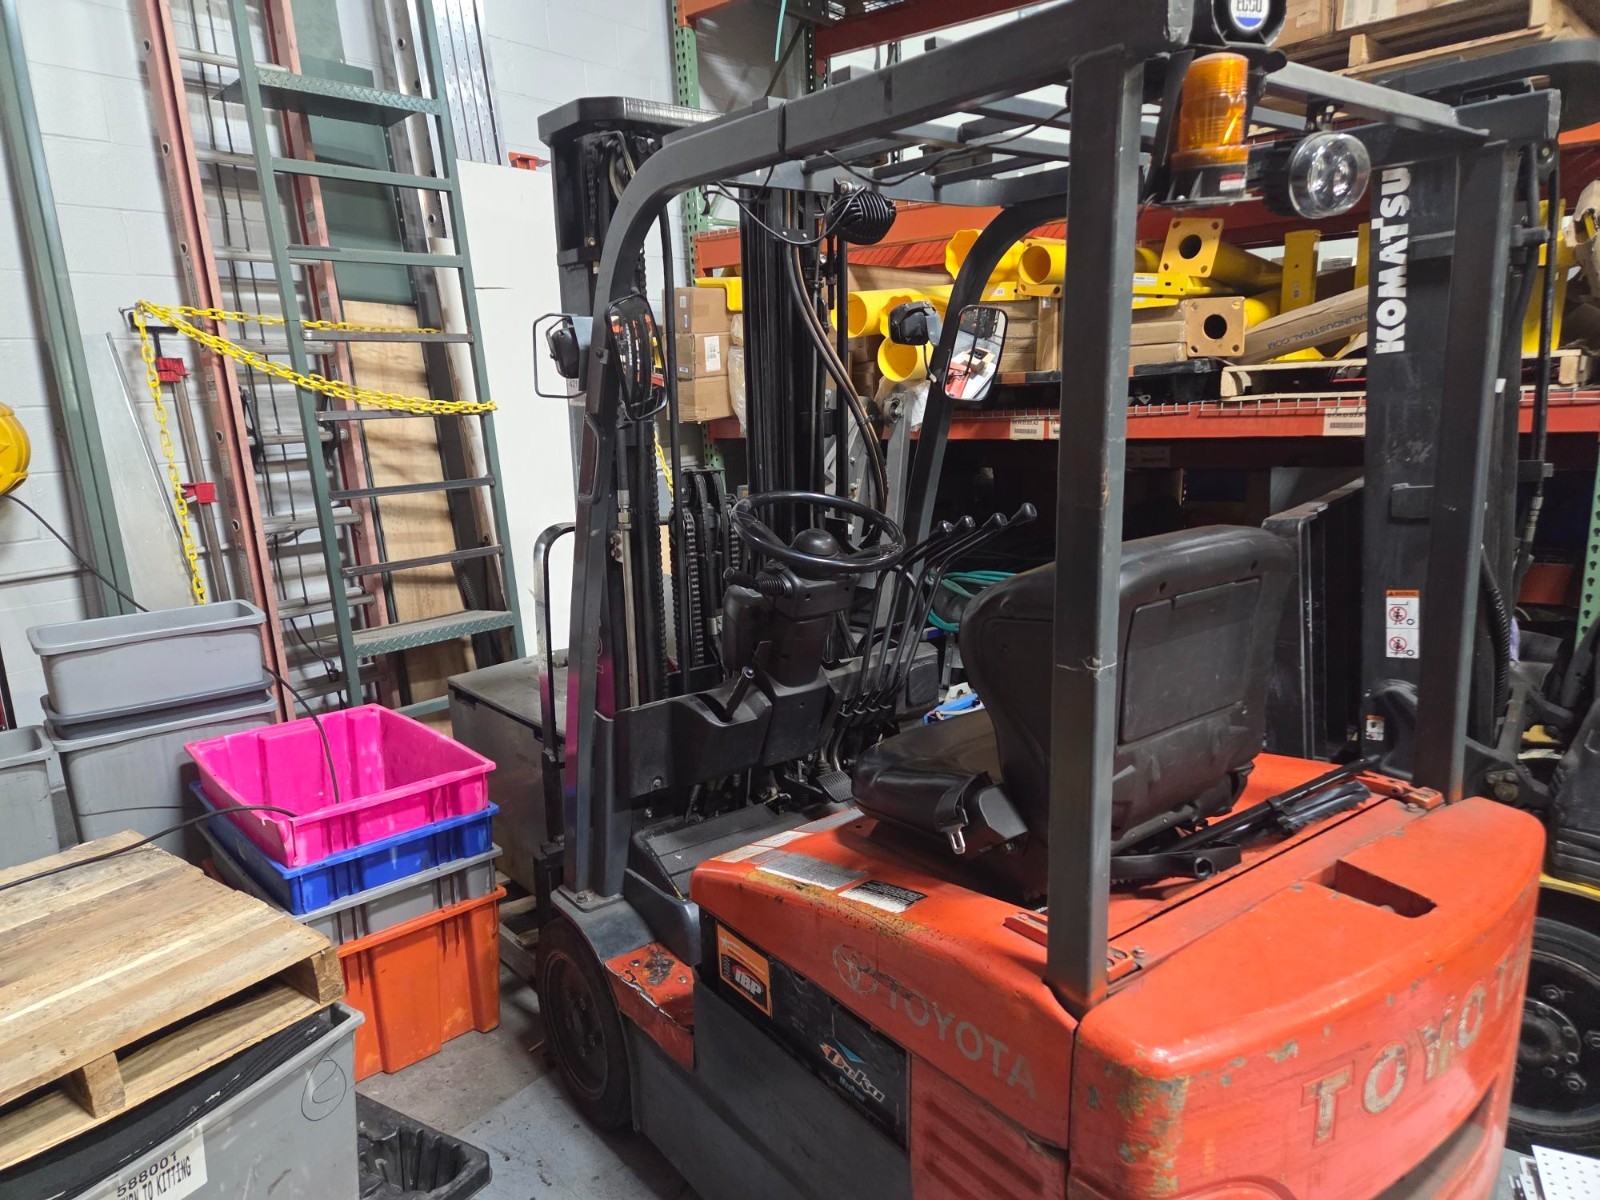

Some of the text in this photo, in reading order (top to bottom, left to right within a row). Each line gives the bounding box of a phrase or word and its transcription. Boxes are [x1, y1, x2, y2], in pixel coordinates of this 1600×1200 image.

[1371, 167, 1412, 355] KOMATSU
[734, 968, 762, 996] IBP
[887, 979, 1036, 1099] TOYOTA
[820, 1042, 885, 1102] Deka
[117, 1151, 177, 1197] 588001
[157, 1156, 191, 1196] KITTING
